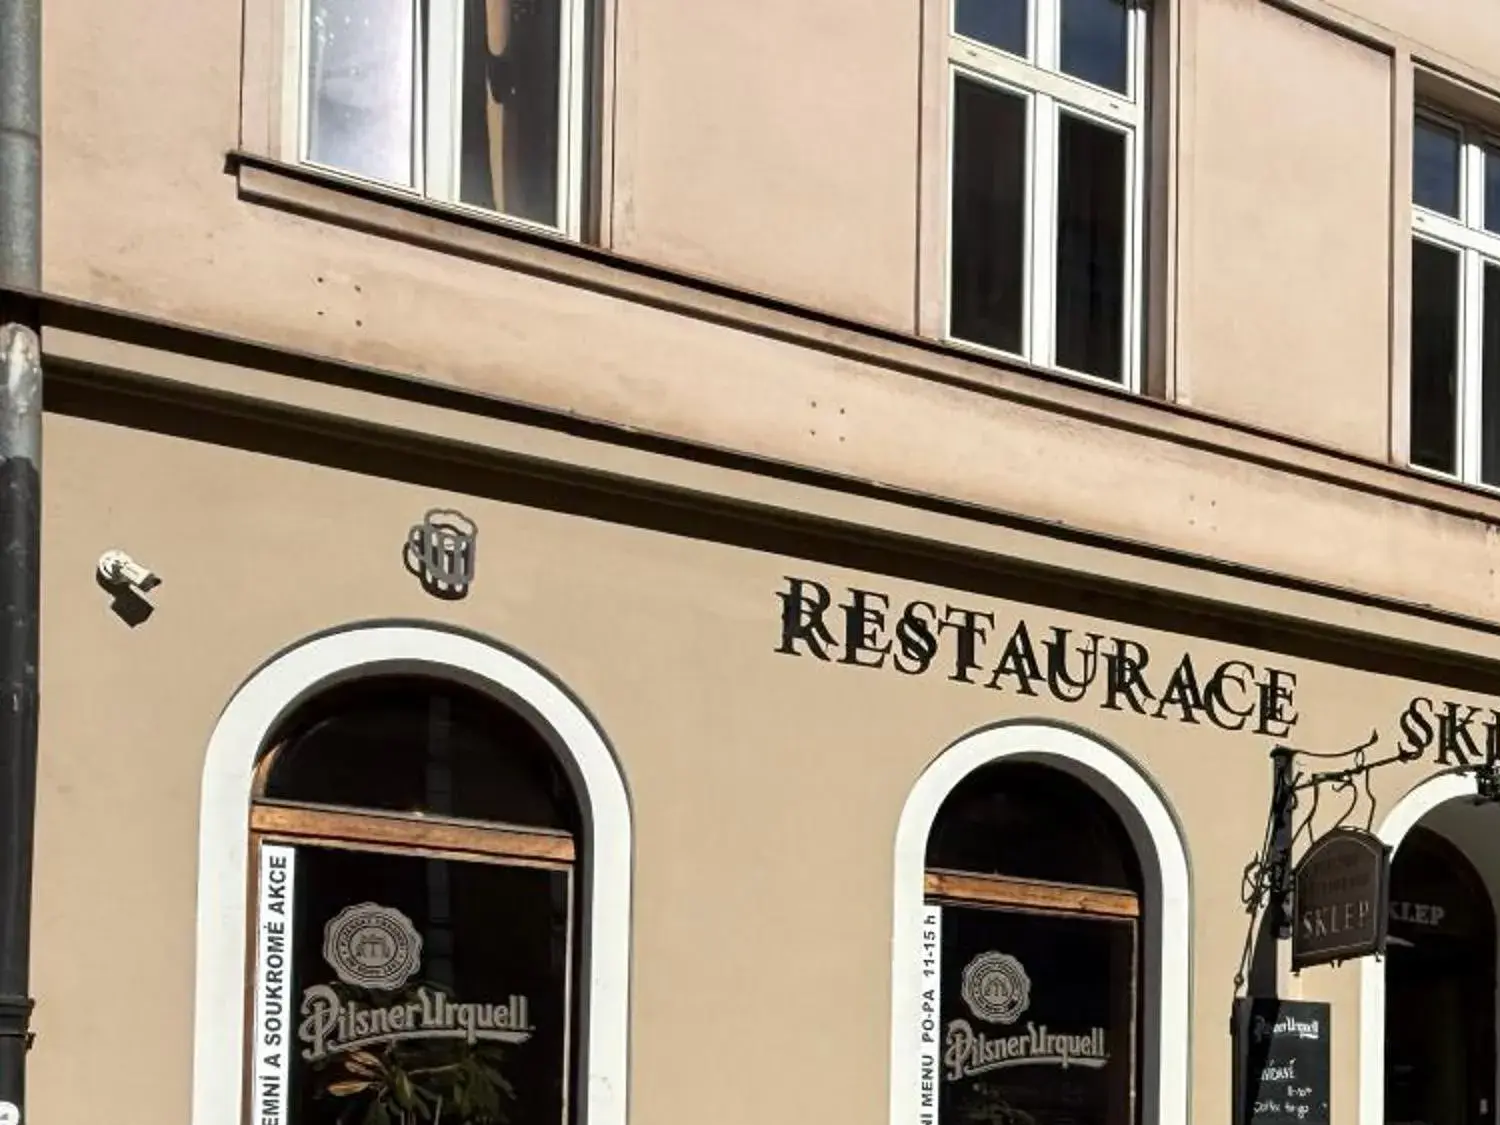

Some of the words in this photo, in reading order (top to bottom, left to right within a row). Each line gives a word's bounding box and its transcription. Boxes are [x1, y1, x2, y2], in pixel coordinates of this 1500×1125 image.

[781, 576, 1299, 726] RESTAURACE
[267, 855, 288, 916] AKCE
[1302, 900, 1370, 939] SKLEP
[1388, 901, 1446, 926] KLEP
[923, 930, 936, 977] 11-15
[263, 921, 285, 1047] SOUKROMÉ
[298, 983, 423, 1063] Pilsner
[417, 986, 529, 1045] Urquell
[921, 988, 936, 1043] PO-PA
[263, 1053, 281, 1069] A
[944, 1018, 1031, 1082] Pilsner
[1026, 1021, 1106, 1070] Urquell
[921, 1054, 935, 1108] MENU
